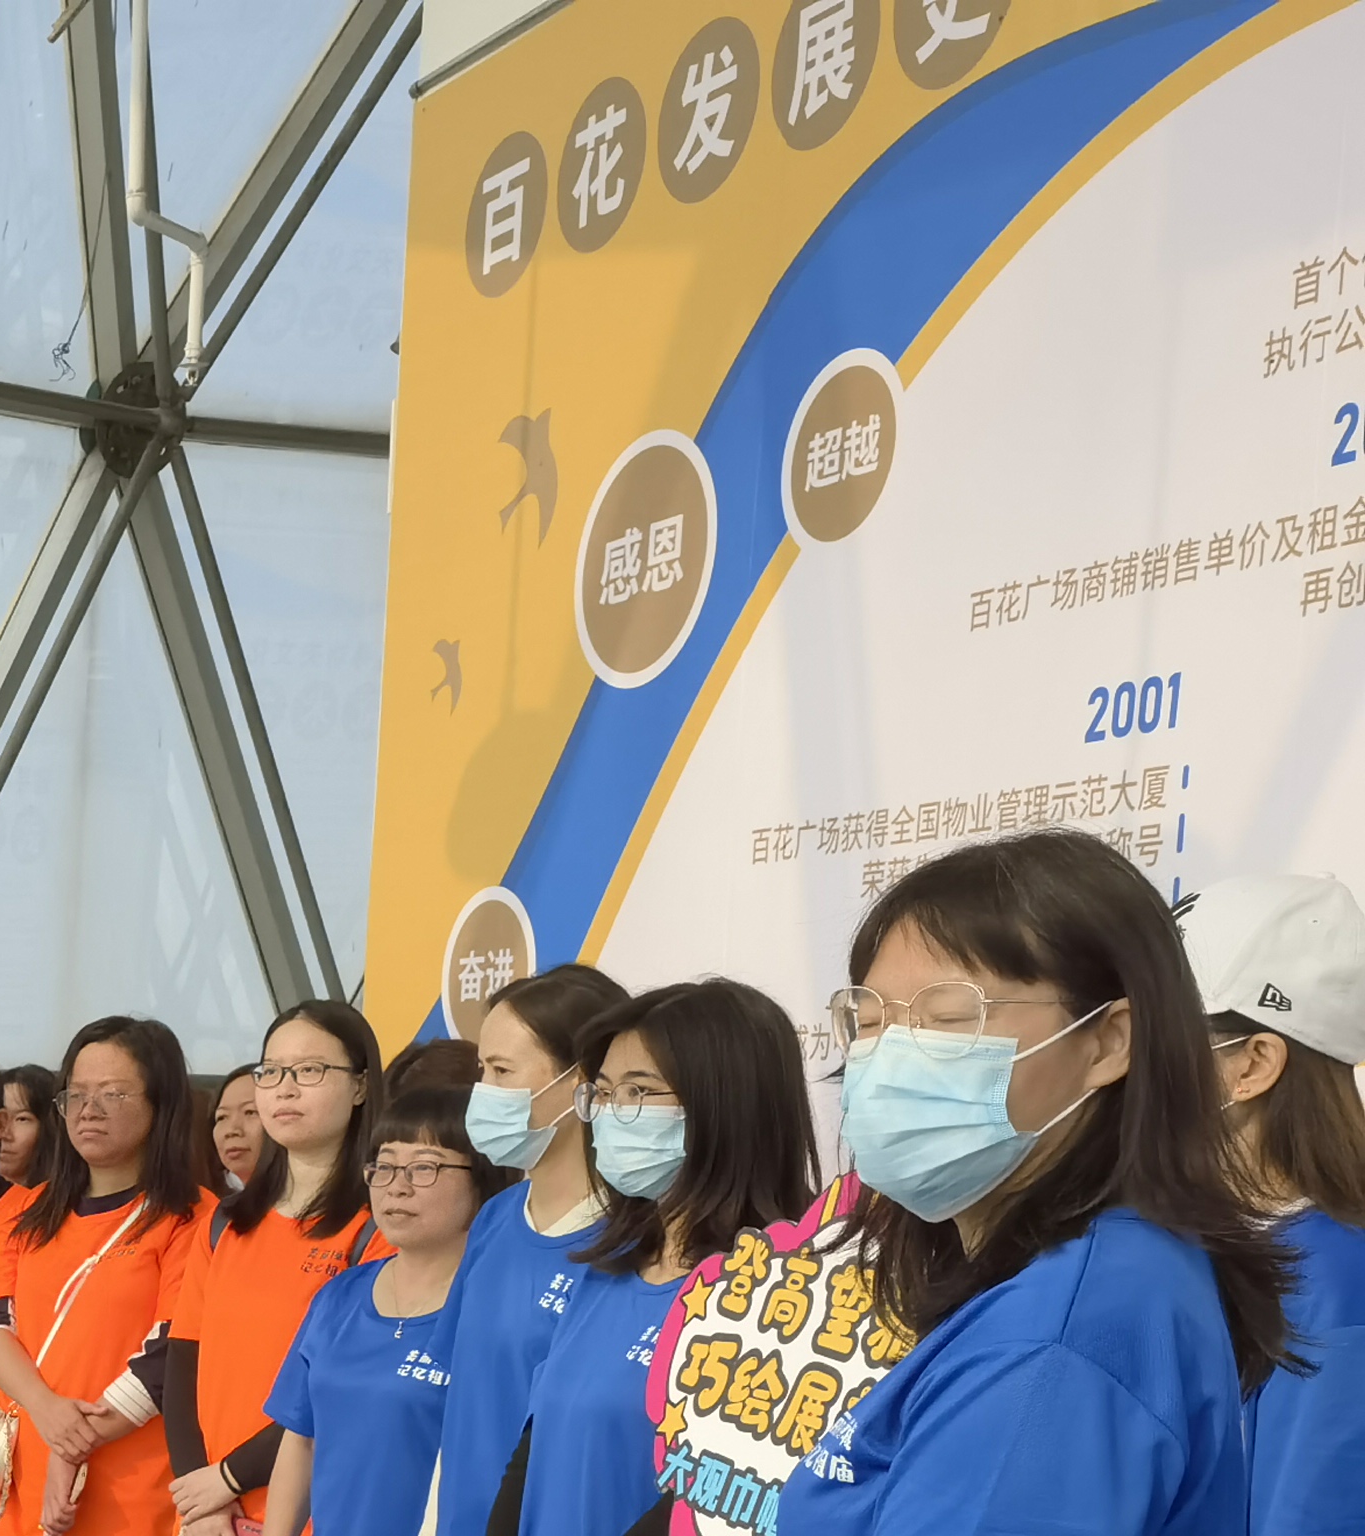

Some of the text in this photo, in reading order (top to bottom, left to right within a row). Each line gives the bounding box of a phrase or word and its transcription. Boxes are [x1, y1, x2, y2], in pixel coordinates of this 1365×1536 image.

[805, 414, 881, 494] 超越
[599, 514, 684, 608] 感恩
[1084, 672, 1182, 743] 2001
[751, 764, 1170, 865] 百花广场获得全国物业管理示范大厦
[458, 948, 514, 1002] 奋进
[679, 1340, 875, 1454] 巧绘展
